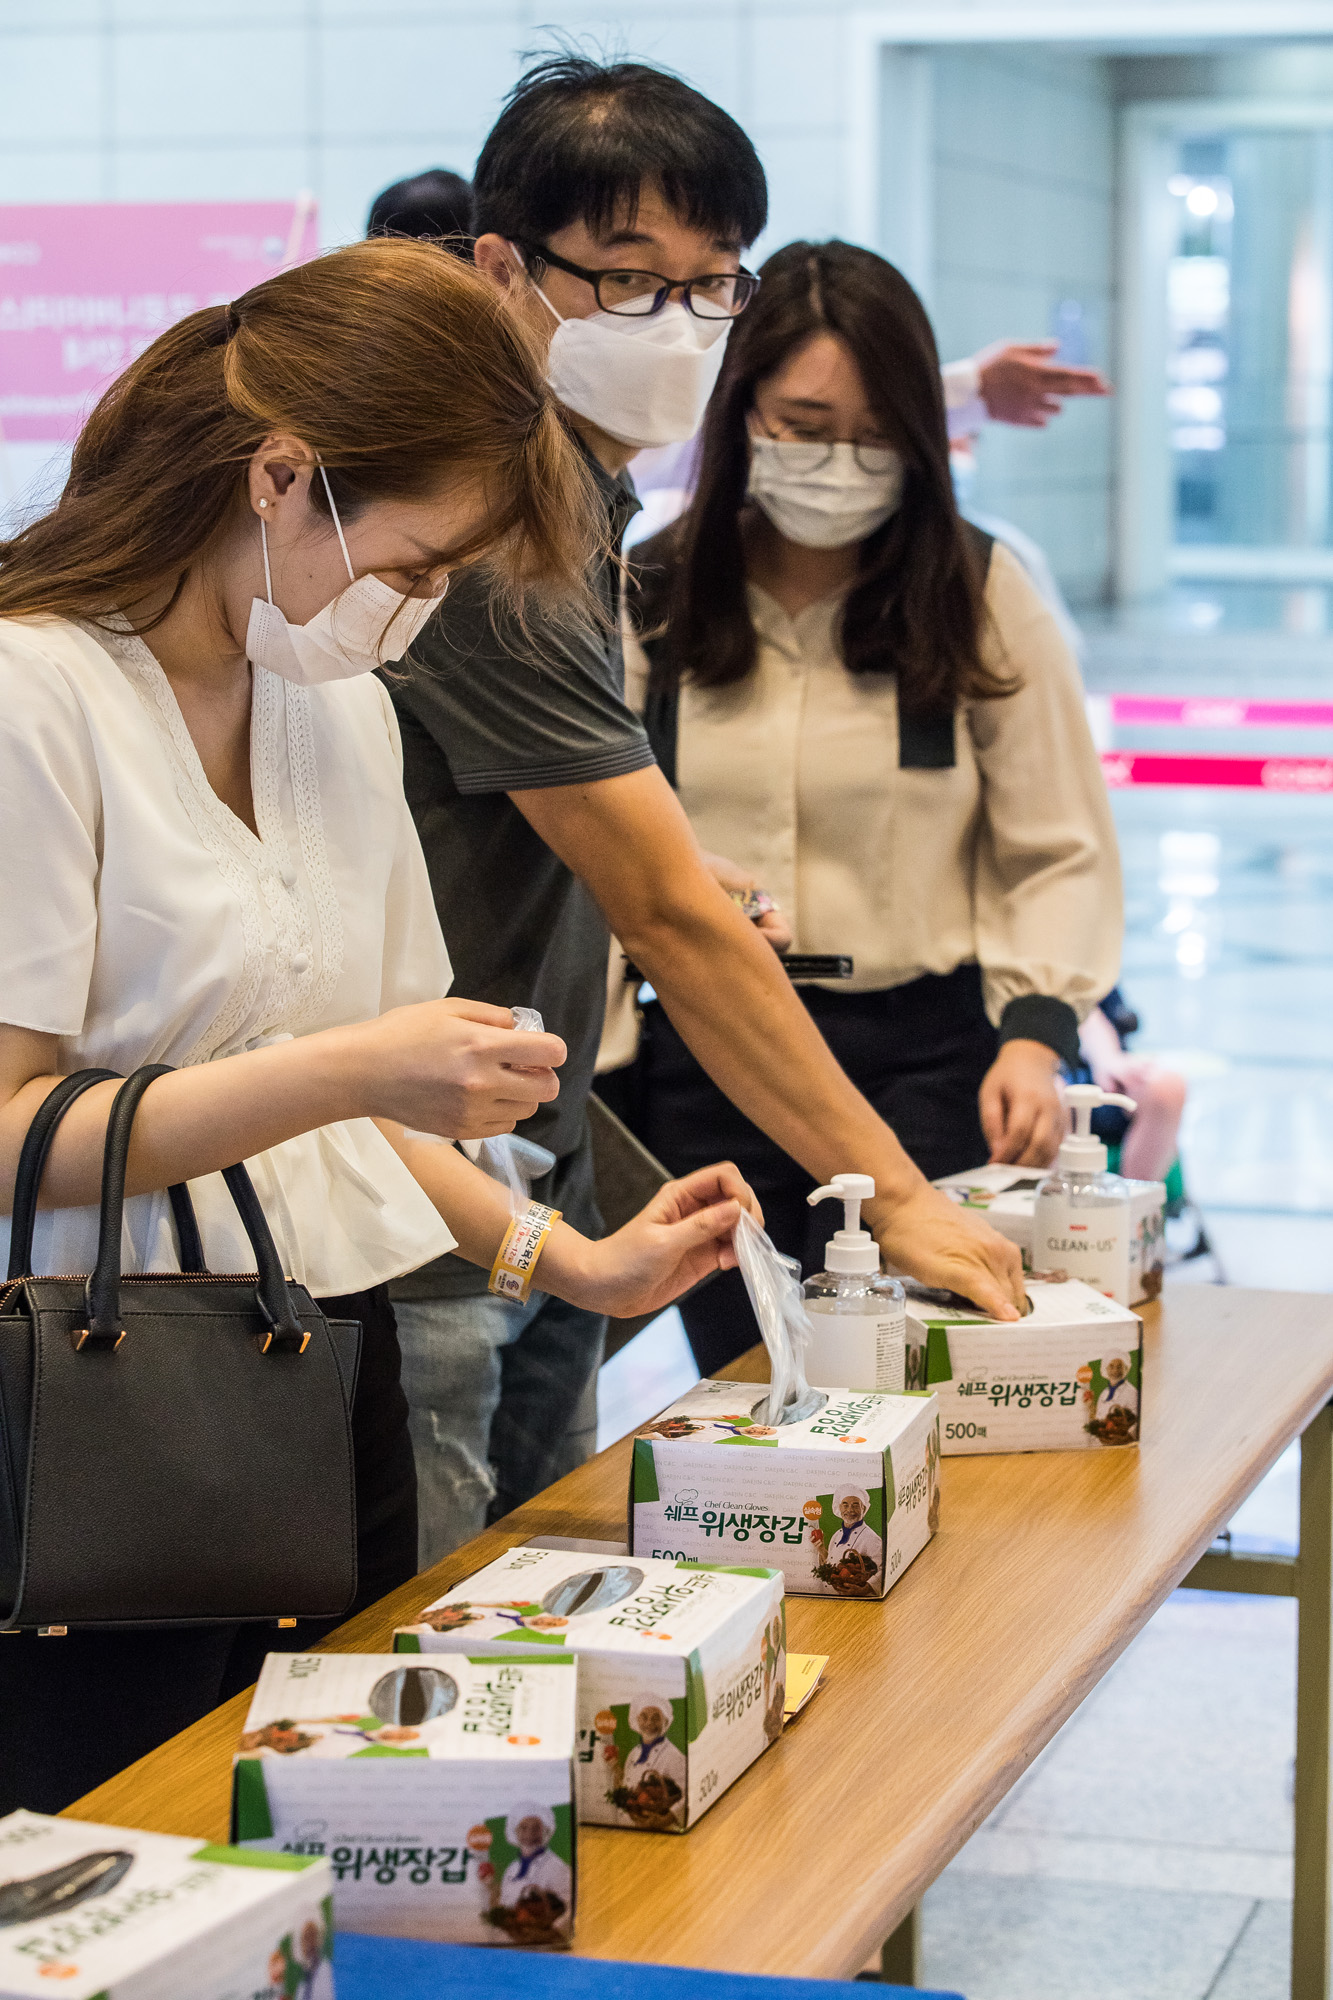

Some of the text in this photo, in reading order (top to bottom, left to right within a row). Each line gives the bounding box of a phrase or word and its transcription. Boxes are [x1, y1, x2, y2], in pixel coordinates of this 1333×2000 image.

[957, 1382, 1081, 1409] 쉐프 위생장갑
[664, 1505, 808, 1544] 쉐프 위생장갑
[704, 1500, 770, 1511] Chef Clean Gloves
[608, 1584, 694, 1632] 위생장갑
[331, 1847, 475, 1886] 위생장갑
